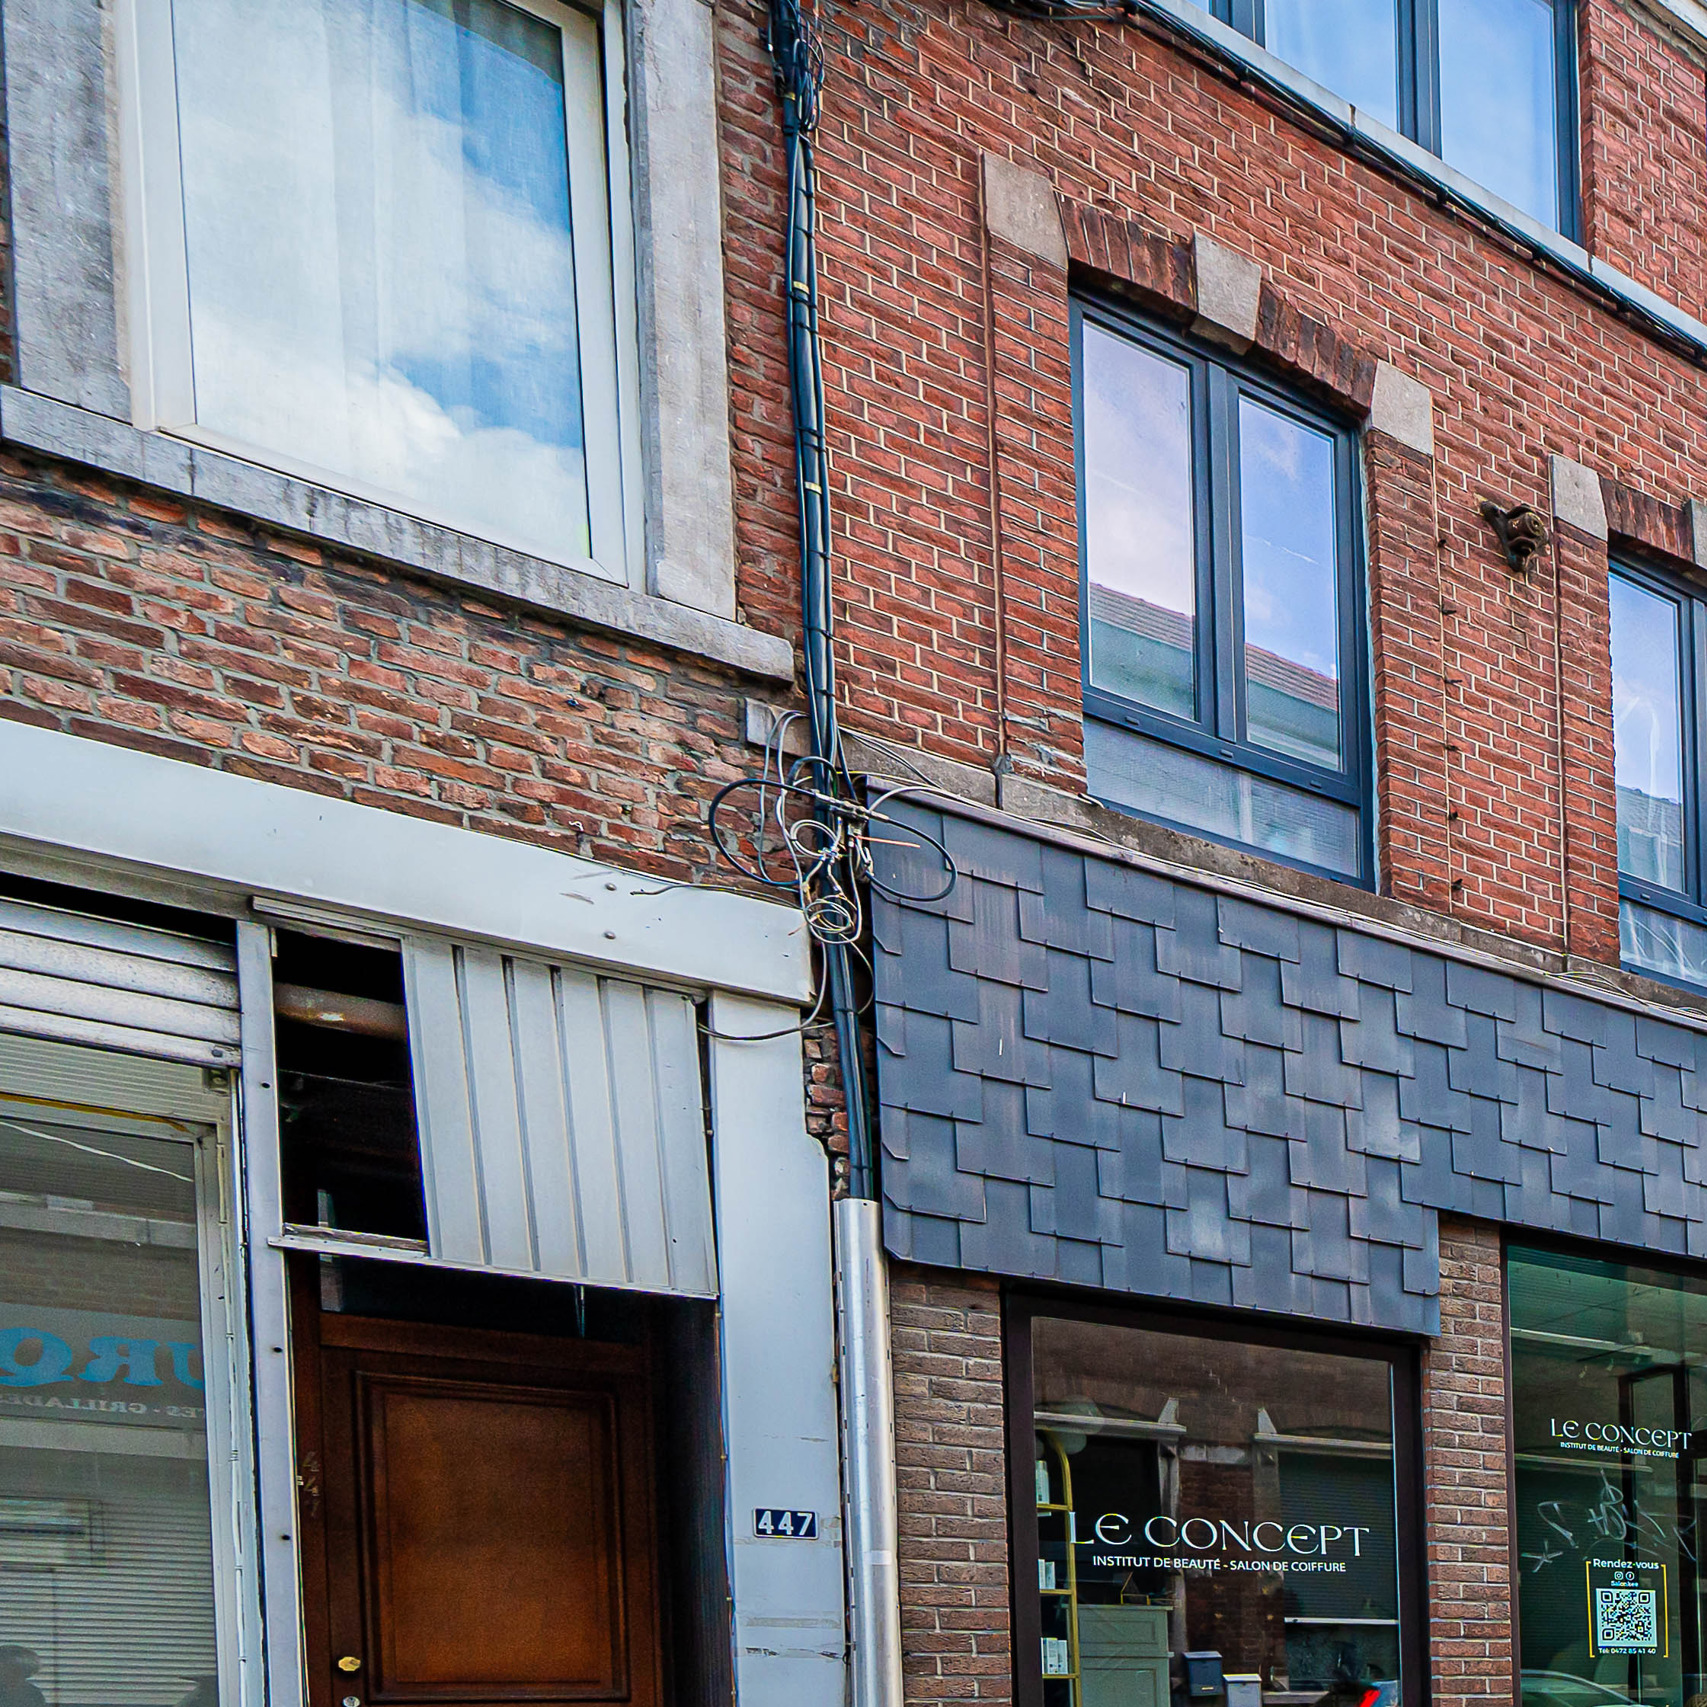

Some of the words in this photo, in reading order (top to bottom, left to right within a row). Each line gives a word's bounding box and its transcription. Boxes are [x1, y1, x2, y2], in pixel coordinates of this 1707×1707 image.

[1551, 1418, 1580, 1438] LE
[1584, 1422, 1693, 1450] CONCEPT
[1560, 1441, 1587, 1450] INSTITUT
[1587, 1443, 1597, 1451] DE
[758, 1510, 813, 1536] 447
[1068, 1511, 1132, 1546] LE
[1144, 1515, 1370, 1557] CONCEPT
[1093, 1555, 1151, 1567] INSTITUT
[1153, 1557, 1171, 1569] DE
[1173, 1557, 1221, 1570] BEAUTÉ
[1229, 1560, 1270, 1572] SALON
[1272, 1561, 1289, 1572] DE
[1291, 1562, 1347, 1573] COIFFURE
[1593, 1558, 1660, 1570] Rendez-vous
